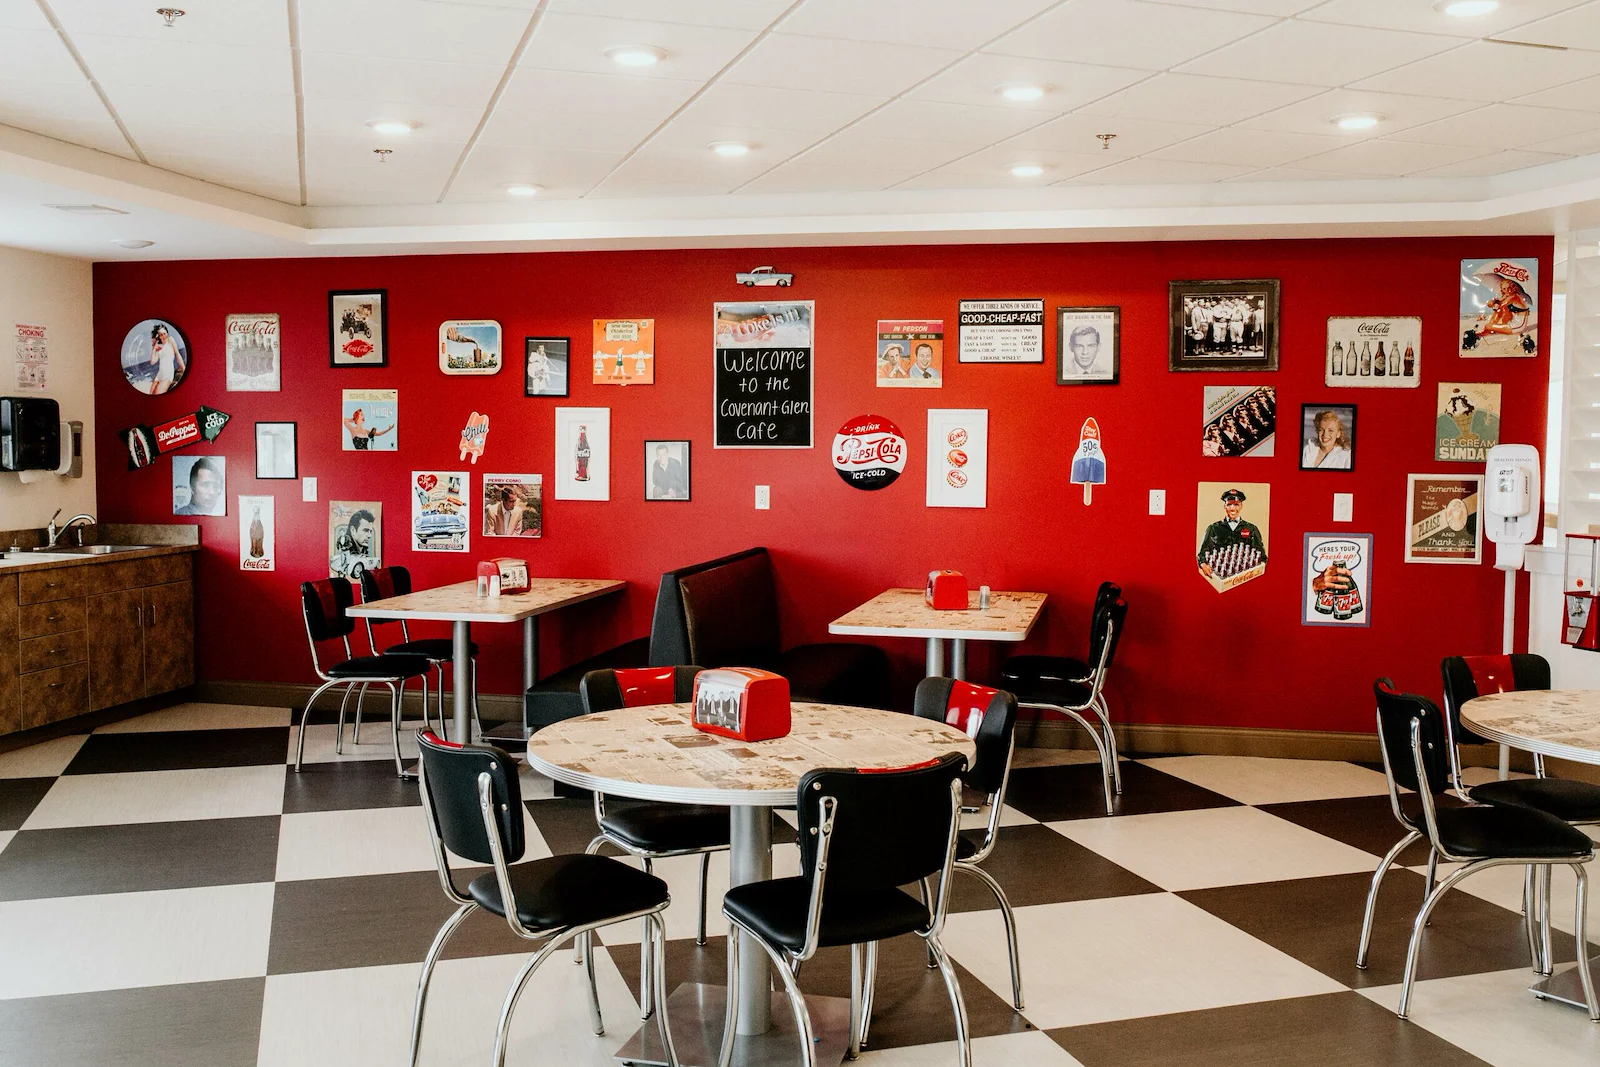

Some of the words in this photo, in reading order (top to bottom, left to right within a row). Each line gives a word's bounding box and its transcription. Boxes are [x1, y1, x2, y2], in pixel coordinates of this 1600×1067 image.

[1000, 302, 1013, 310] KINDS
[961, 313, 1042, 323] GOOD-CHEAP-FAST
[737, 316, 771, 336] Coke
[18, 328, 44, 338] CHOKING
[723, 350, 805, 373] Welcome
[739, 377, 758, 393] to
[766, 377, 790, 391] the
[721, 399, 780, 417] Covenant
[781, 400, 810, 415] Glen
[206, 412, 218, 422] ICE
[205, 417, 225, 429] COLD
[736, 421, 778, 440] Cafe
[1439, 438, 1456, 447] ICE
[1460, 438, 1496, 448] CREAM
[1424, 485, 1469, 493] Remember
[1418, 515, 1441, 538] PLEASE
[1427, 538, 1456, 546] Thank
[1319, 552, 1341, 562] Fresh
